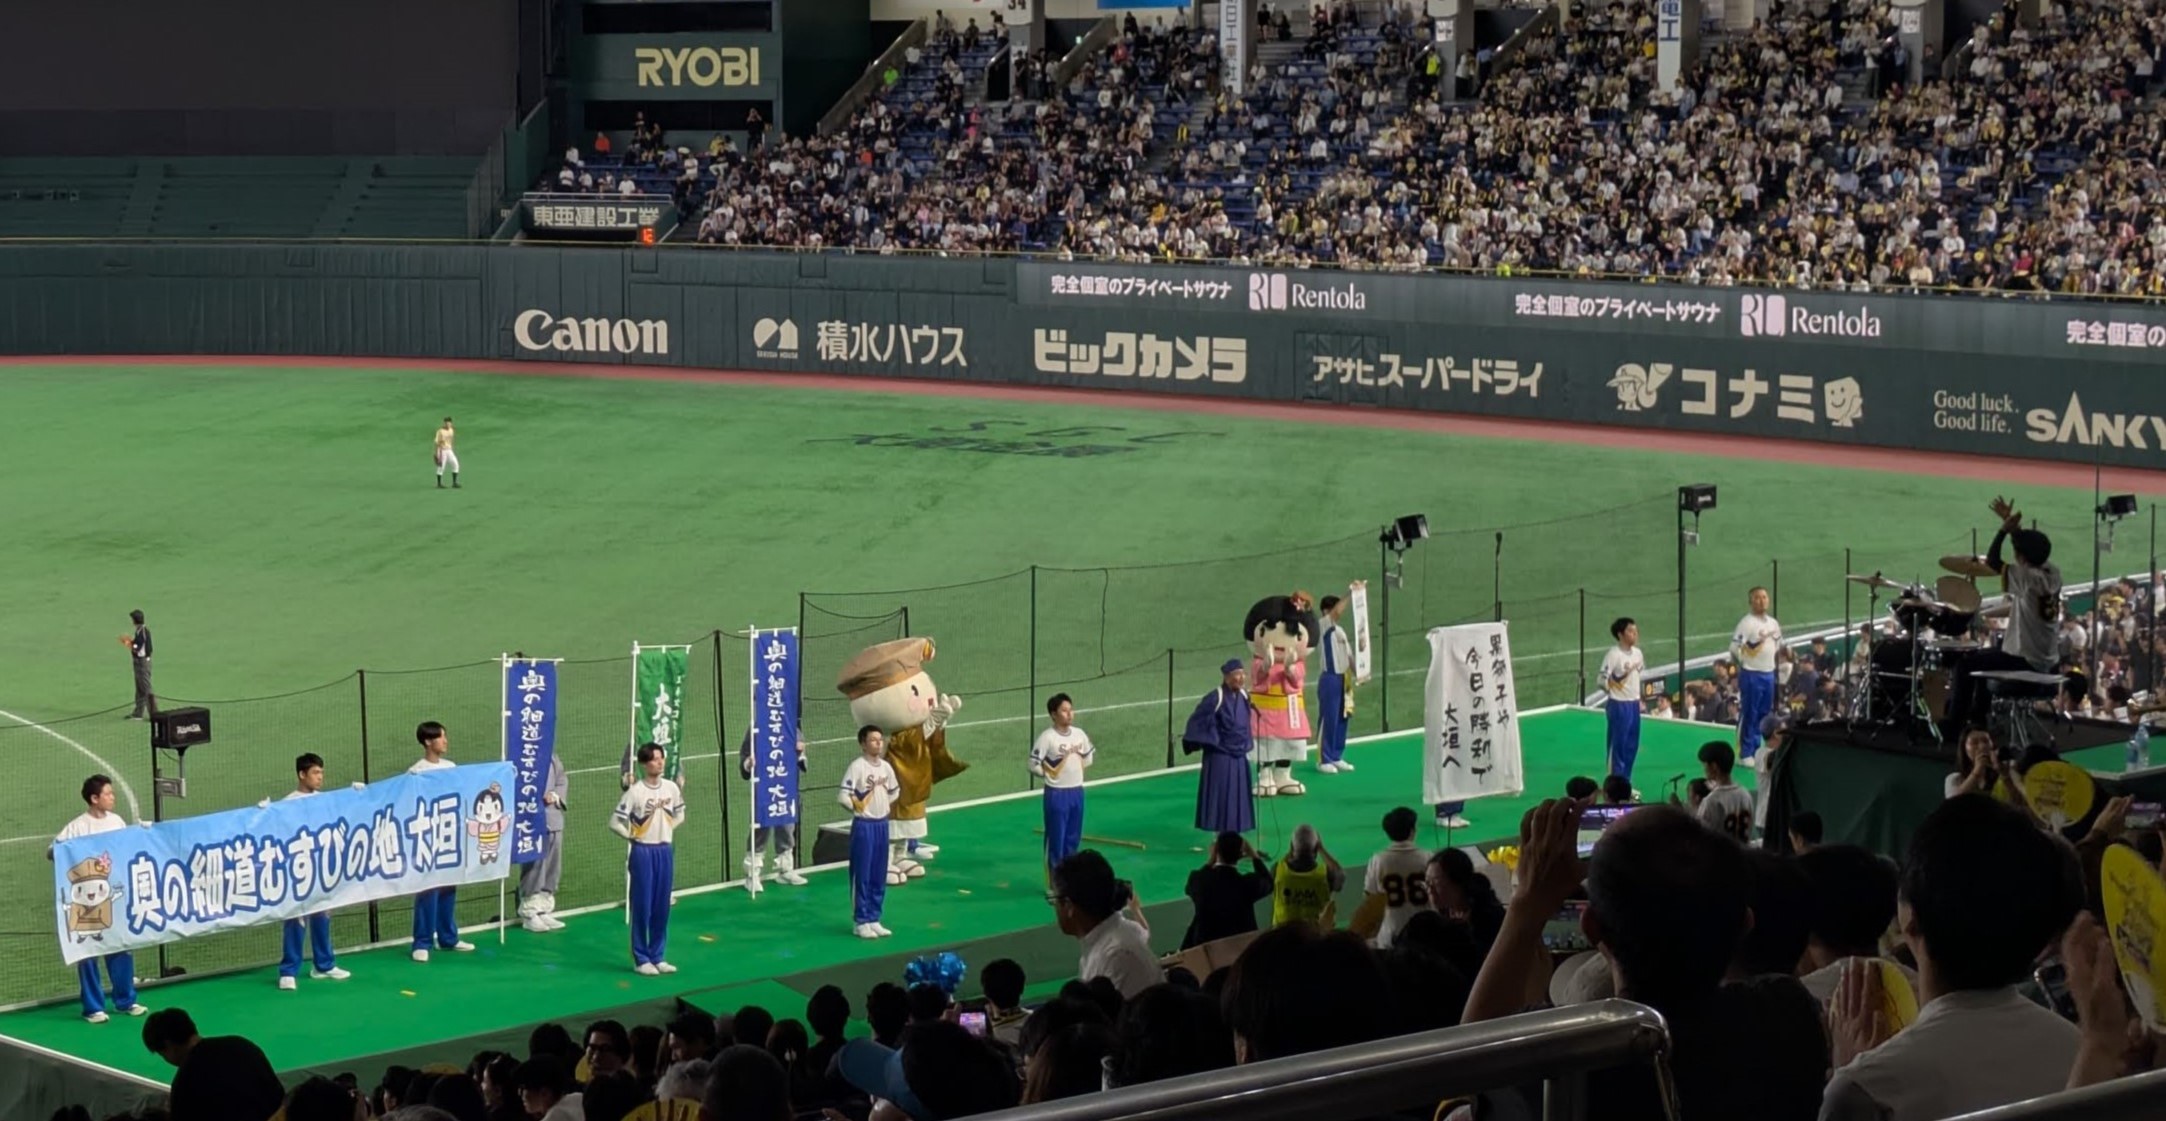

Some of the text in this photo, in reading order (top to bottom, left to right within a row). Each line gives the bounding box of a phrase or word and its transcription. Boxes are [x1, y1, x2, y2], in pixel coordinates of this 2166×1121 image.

[635, 46, 761, 88] RYOBI
[533, 205, 660, 228] 東亜建設工業
[1051, 274, 1232, 300] 完全個室のプライベートサウナ
[1291, 282, 1366, 310] Rentola
[1515, 292, 1721, 325] 完全個室のプライベートサウナ
[513, 309, 668, 355] Canon
[1791, 305, 1881, 338] Rentola
[2066, 319, 2166, 348] 完全個室の
[816, 320, 968, 368] 積水ハウス
[1034, 328, 1248, 383] ビックカメラ
[1312, 353, 1543, 397] アサヒスーパードライ
[1680, 368, 1815, 424] コナミ
[1933, 390, 2019, 414] Good luck.
[1933, 410, 2012, 434] Good life.
[652, 682, 673, 754] 大垣
[763, 639, 788, 818] 奥の細道むすびの地 大垣
[1442, 701, 1462, 769] 大垣へ
[1465, 646, 1494, 785] 今日の勝利で
[516, 669, 547, 855] 奥の細道むすびの地 大垣
[127, 792, 463, 936] 奥の細道むすびの地 大垣
[1383, 872, 1429, 908] 86
